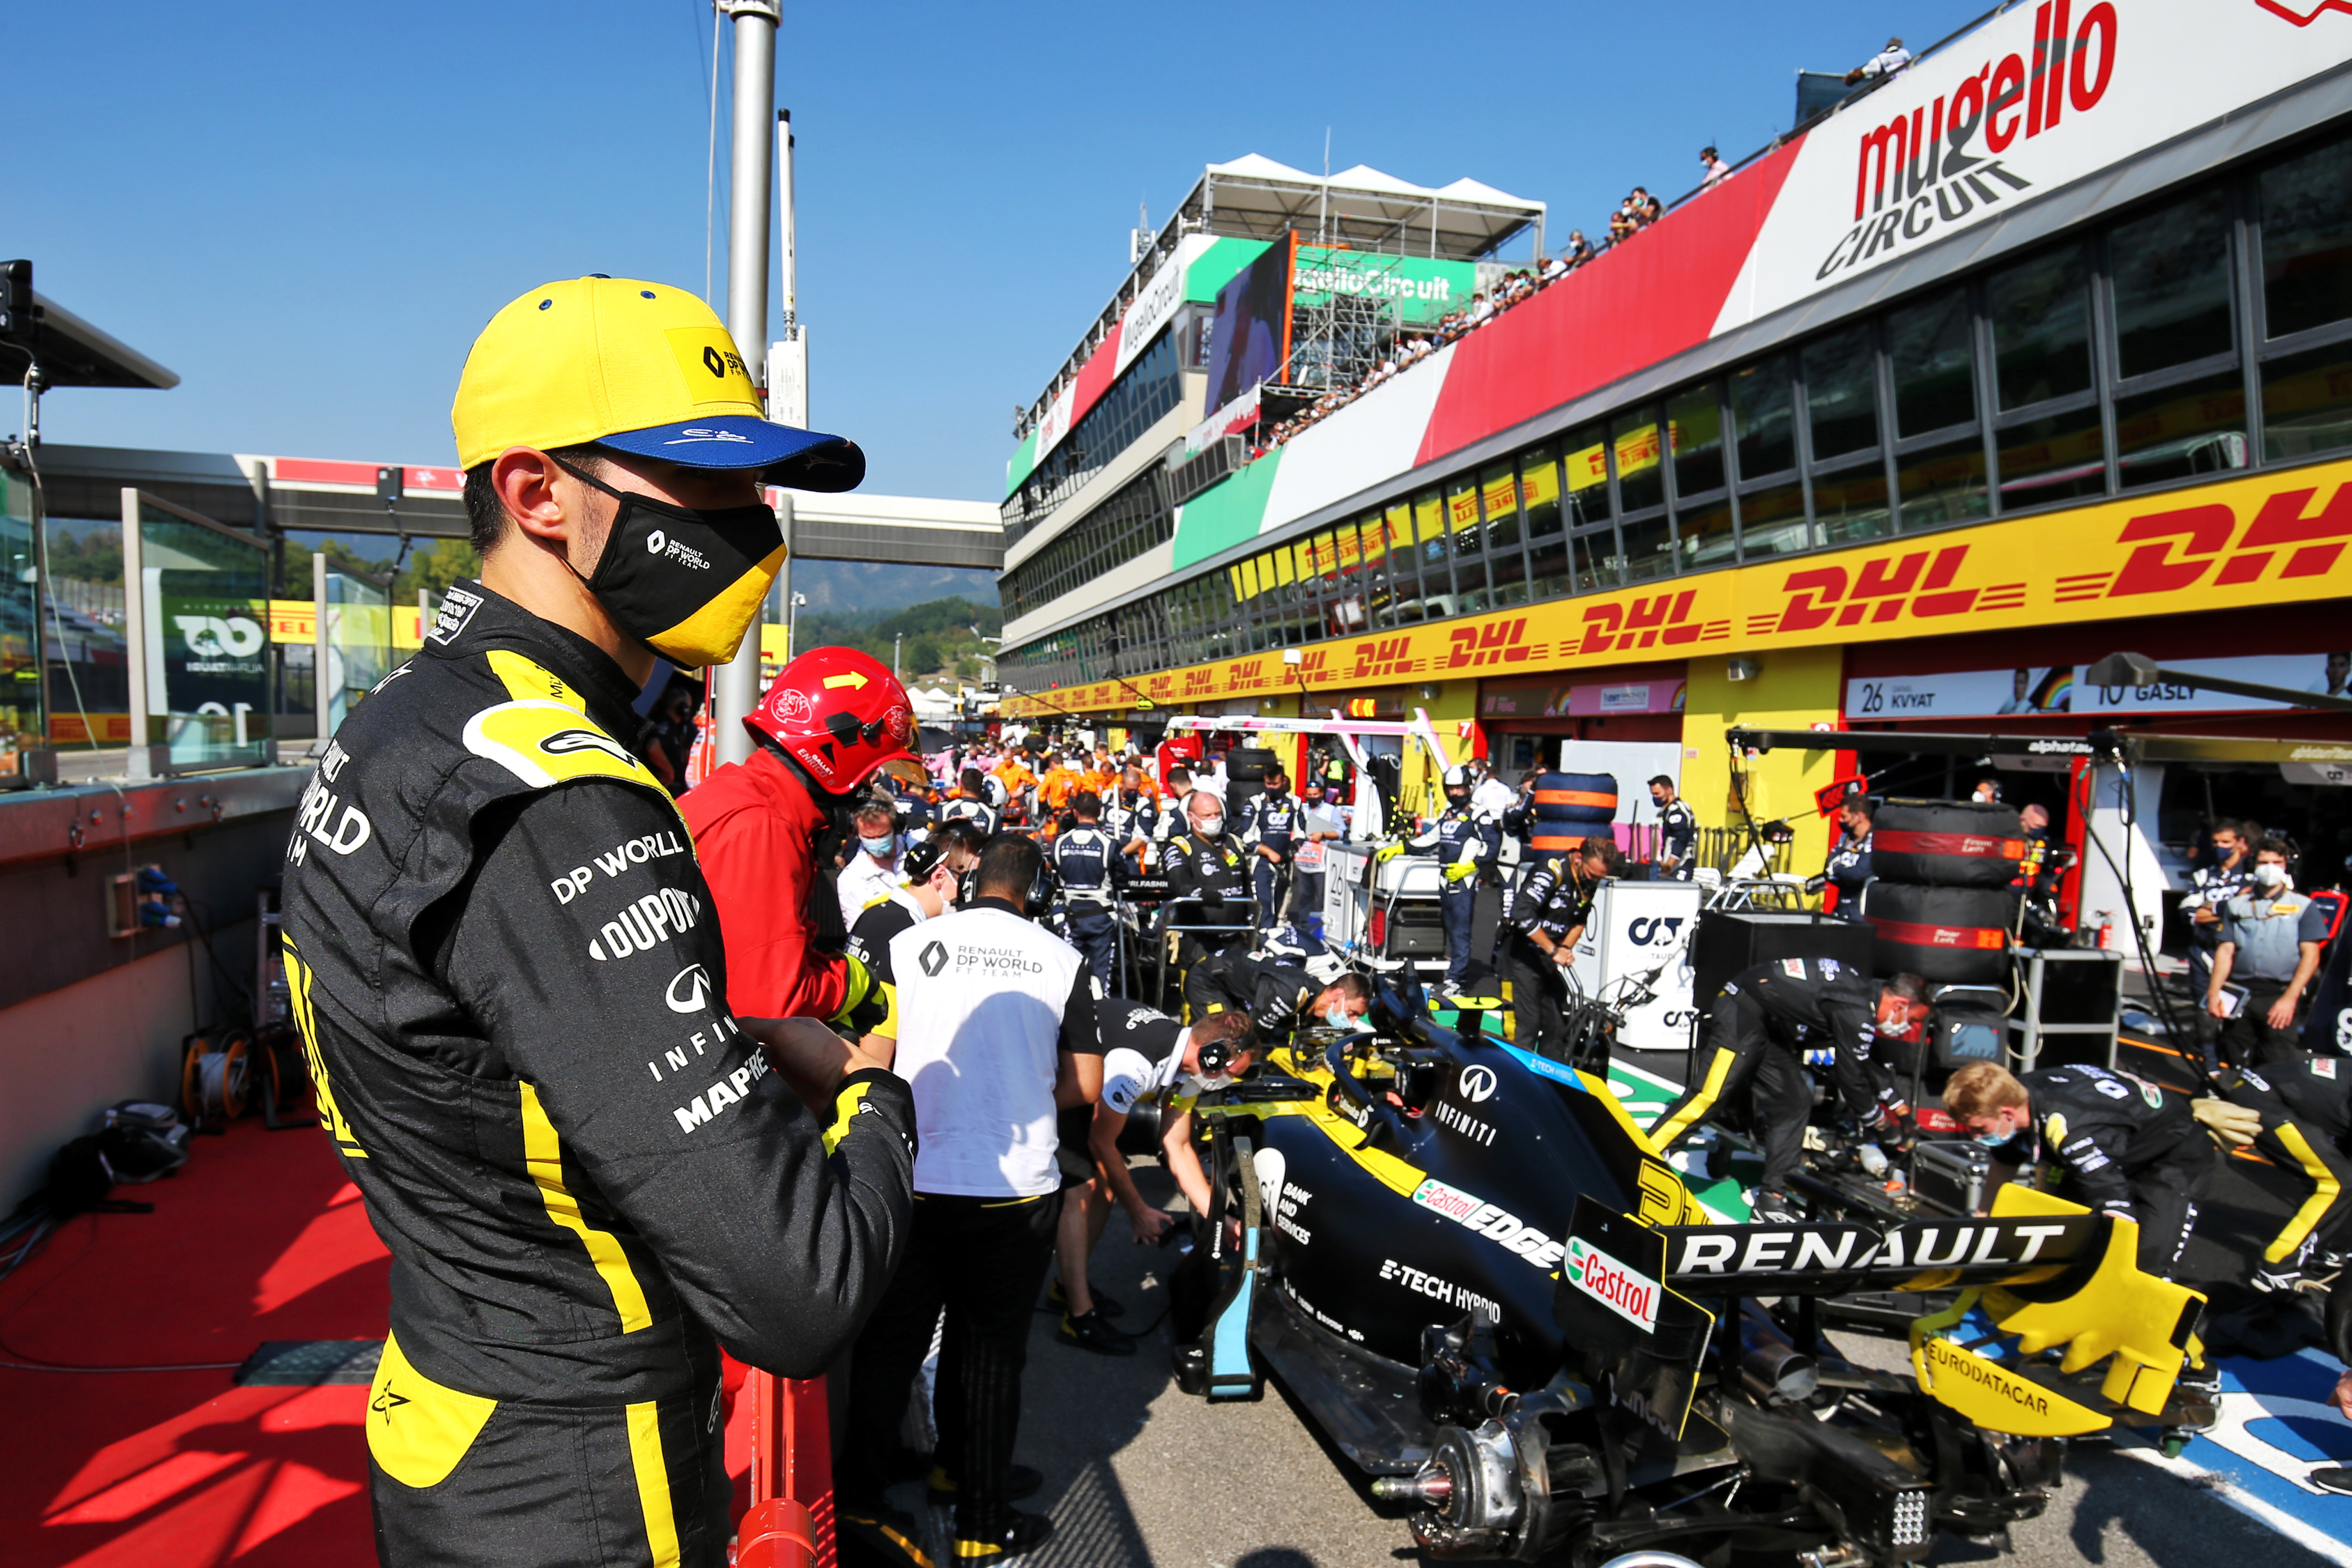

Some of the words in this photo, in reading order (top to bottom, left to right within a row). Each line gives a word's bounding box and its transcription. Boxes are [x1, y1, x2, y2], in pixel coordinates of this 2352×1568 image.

[1856, 0, 2117, 222] mugello
[1816, 159, 2034, 280] CIRCUIT
[669, 539, 703, 558] RENAULT
[2106, 481, 2352, 598] DH
[666, 544, 680, 555] DP
[681, 550, 710, 569] WORLD
[678, 557, 698, 570] TEAM
[1776, 544, 1981, 632] DHL
[1579, 589, 1705, 654] DHL
[1353, 637, 1414, 678] DHL
[1448, 617, 1531, 668] DHL
[1185, 669, 1213, 696] DHL
[1229, 660, 1264, 691] DHL
[1283, 651, 1328, 685] DHL
[1862, 683, 1884, 713] 26
[1891, 693, 1936, 710] KVYAT
[2136, 684, 2197, 701] GASLY
[1460, 722, 1472, 738] 7
[797, 748, 828, 778] ENRICO
[812, 754, 833, 776] GALLET
[550, 865, 593, 906] DP
[1330, 863, 1344, 895] 26
[600, 887, 696, 960] DUPONT
[957, 954, 978, 965] DP
[983, 956, 1043, 974] WORLD
[958, 945, 1024, 957] RENAULT
[982, 969, 1021, 978] TEAM
[647, 1014, 739, 1083] INFIN
[1530, 1058, 1555, 1075] E-TECH
[1435, 1100, 1497, 1147] INFINITI
[1278, 1198, 1298, 1217] AND
[1283, 1181, 1313, 1205] BANK
[1277, 1214, 1311, 1245] SERVICES
[1426, 1187, 1477, 1218] Castrol
[1461, 1203, 1565, 1269] EDGE
[1676, 1225, 2066, 1274] RENAULT
[1379, 1259, 1453, 1303] E-TECH
[1584, 1252, 1652, 1323] Castrol
[1930, 1342, 2049, 1417] EURODATACAR
